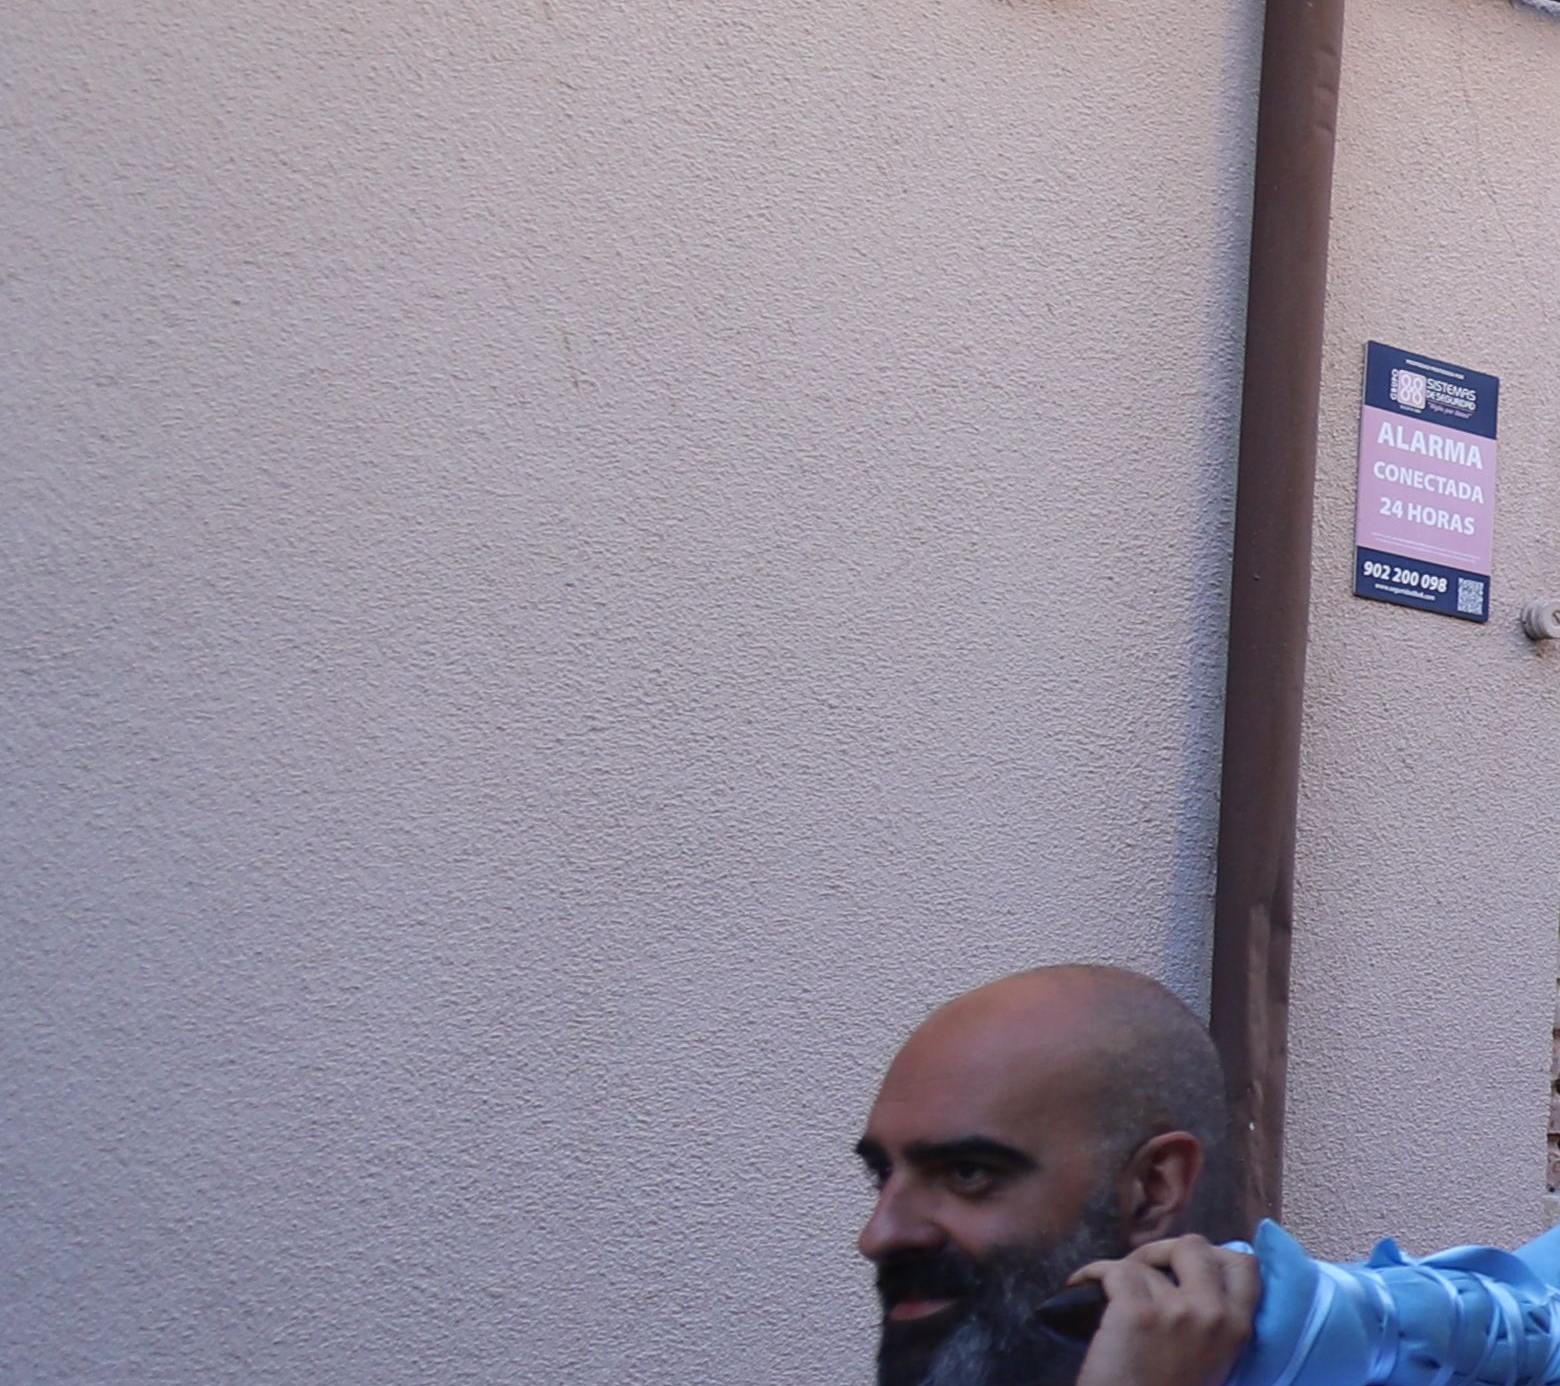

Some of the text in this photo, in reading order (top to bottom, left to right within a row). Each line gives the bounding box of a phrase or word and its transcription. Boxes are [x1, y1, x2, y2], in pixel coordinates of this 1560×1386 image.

[1427, 378, 1477, 402] SISTEMAS
[1377, 421, 1484, 470] ALARMA
[1373, 460, 1485, 505] CONECTADA
[1380, 496, 1475, 536] 24 HORAS
[1363, 560, 1391, 581] 902
[1392, 567, 1419, 587] 200
[1421, 574, 1448, 593] 098
